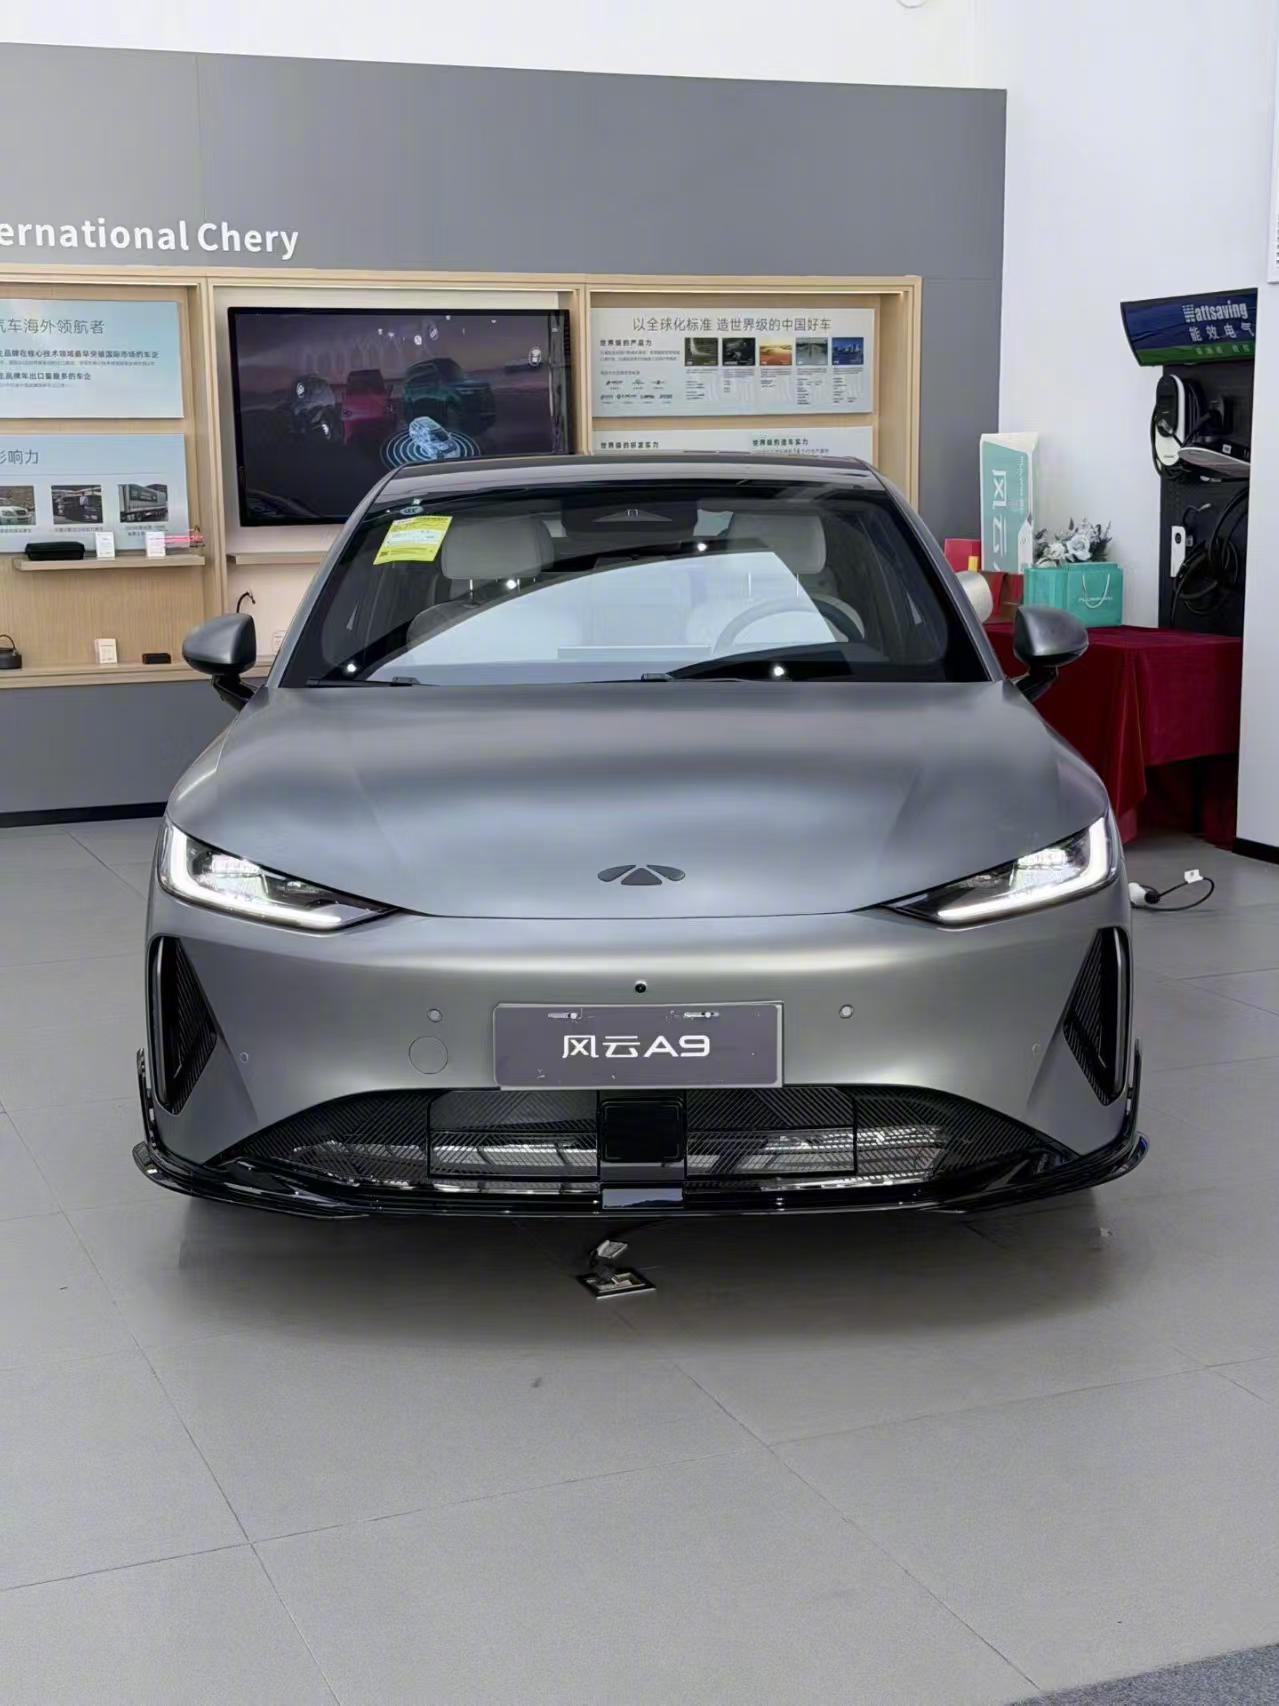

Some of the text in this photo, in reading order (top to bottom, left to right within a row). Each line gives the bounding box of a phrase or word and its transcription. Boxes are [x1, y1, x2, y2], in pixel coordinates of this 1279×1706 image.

[0, 218, 299, 260] ernational Chery
[632, 317, 832, 332] 以全球化标准 造世界级的中国好车
[1189, 322, 1255, 342] 能效电气
[992, 469, 1007, 572] 风云
[562, 1034, 711, 1059] 风云A9
